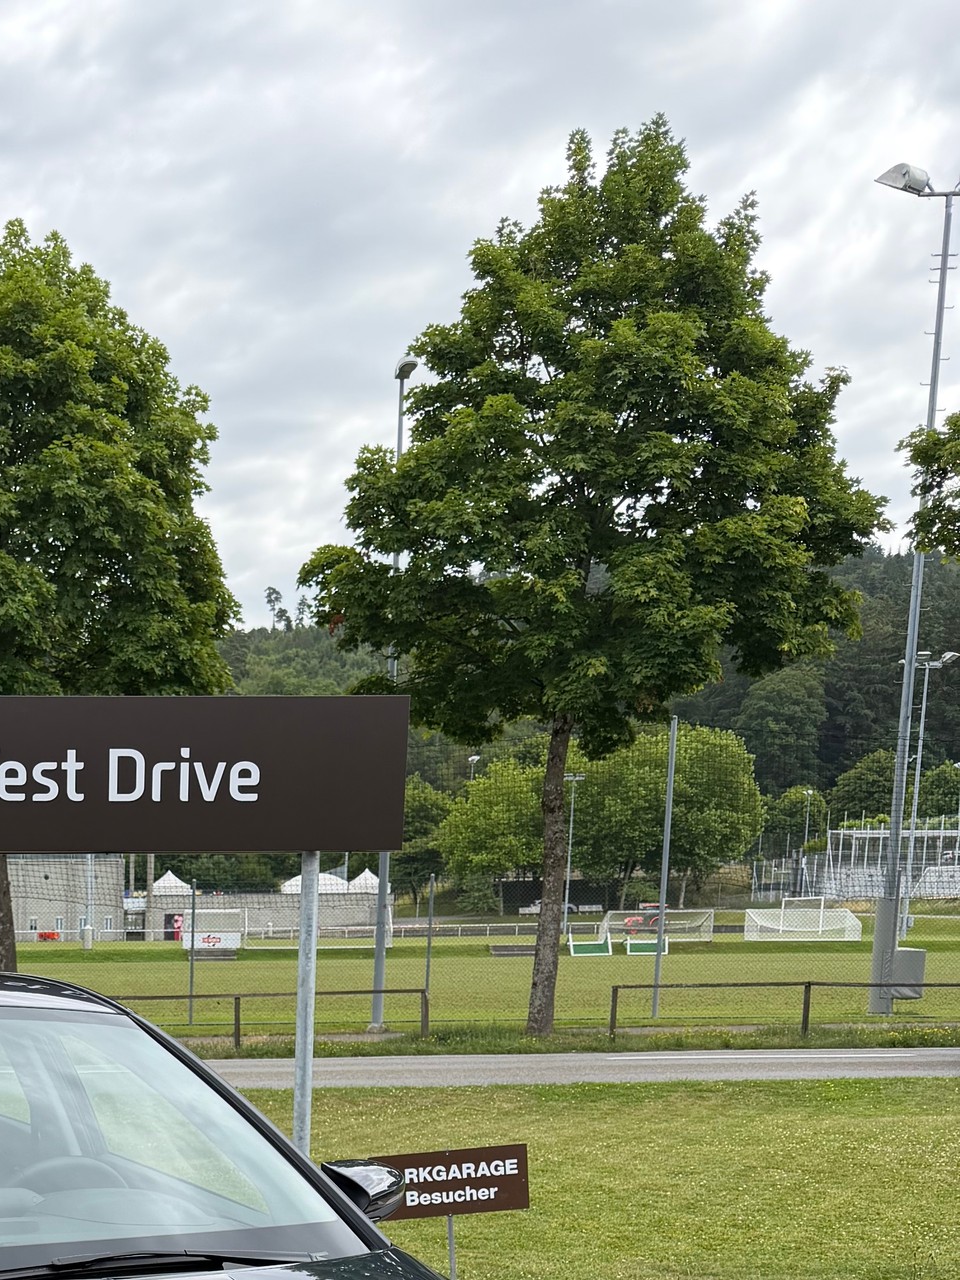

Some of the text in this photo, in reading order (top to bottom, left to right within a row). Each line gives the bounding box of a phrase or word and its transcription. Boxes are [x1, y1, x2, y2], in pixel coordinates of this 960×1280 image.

[108, 747, 261, 802] Drive
[404, 1158, 519, 1184] RKGARAGE
[405, 1185, 499, 1207] Besucher
